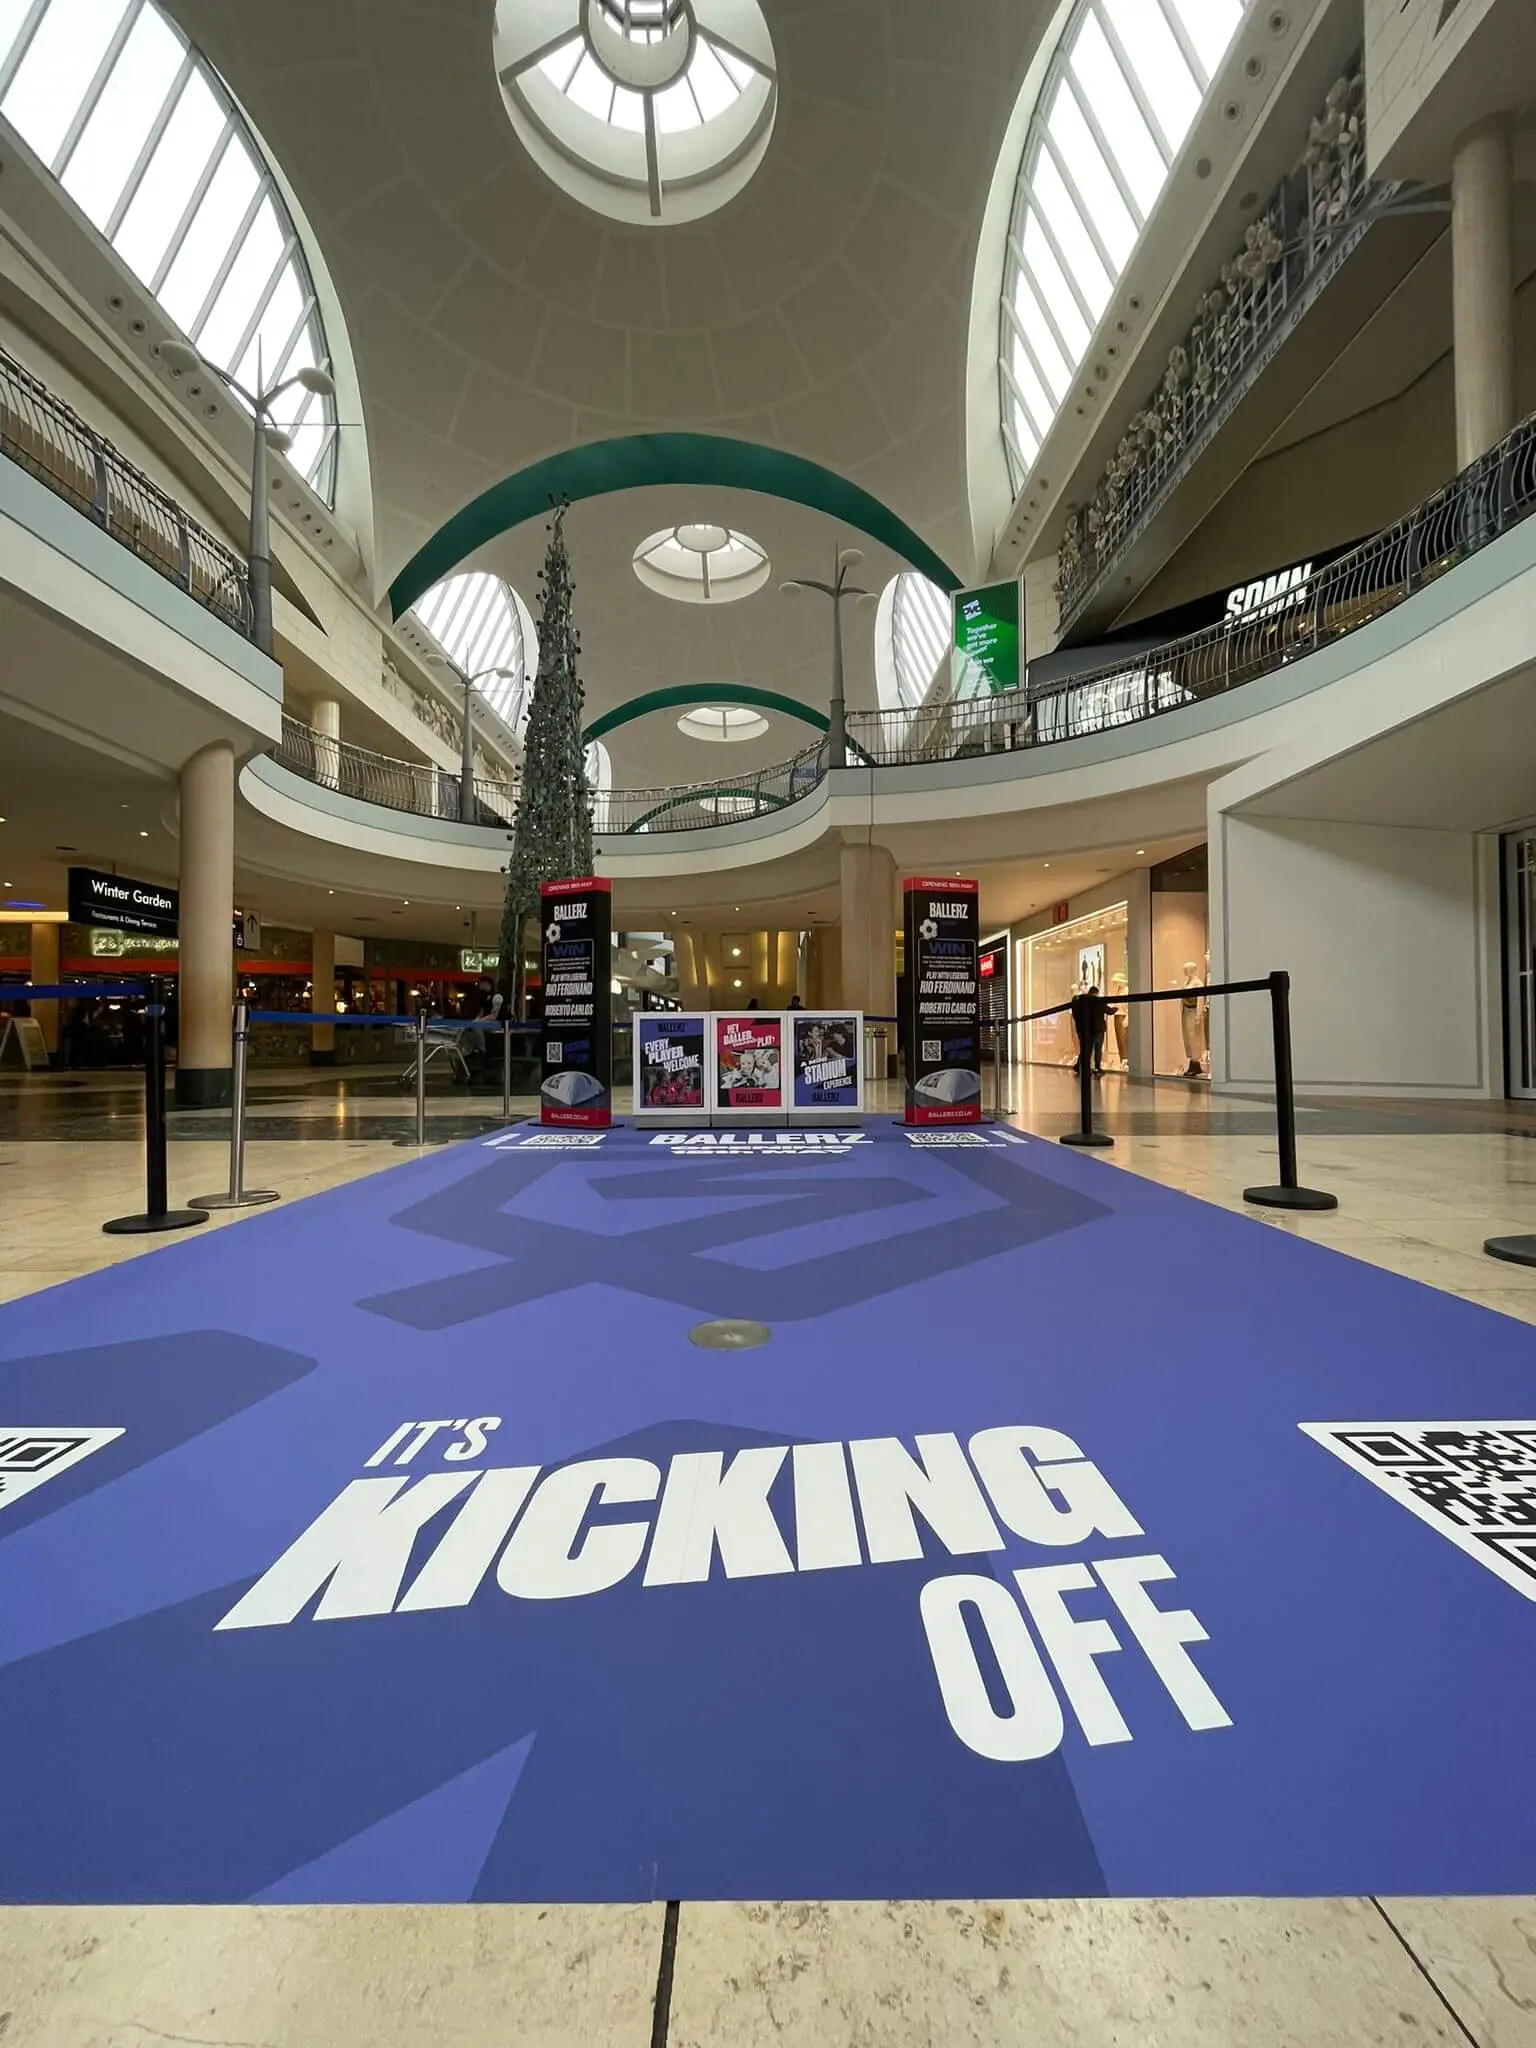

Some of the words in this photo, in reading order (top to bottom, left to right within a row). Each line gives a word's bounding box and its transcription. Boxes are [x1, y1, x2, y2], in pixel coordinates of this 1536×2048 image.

[1224, 562, 1312, 629] SDMN
[92, 880, 130, 900] Winter
[133, 890, 172, 910] Garden
[554, 902, 588, 921] BALLERZ
[929, 902, 968, 919] BALLERZ
[552, 944, 585, 956] WIN
[929, 942, 966, 956] WIN
[920, 981, 934, 994] RIO
[934, 981, 976, 994] FERDINAND
[570, 1003, 594, 1016] CARLOS
[919, 1002, 950, 1014] ROBERTO
[950, 1002, 977, 1014] CARLOS
[645, 1038, 670, 1054] EVERY
[723, 1030, 752, 1045] BALLER
[648, 1045, 684, 1064] PLAYER
[663, 1054, 700, 1072] WELCOME
[804, 1059, 846, 1085] STADIUM
[823, 1076, 852, 1090] EXPERIENCE
[649, 1134, 874, 1144] BALLERZ
[363, 1416, 501, 1468] IT'S
[213, 1425, 1145, 1631] KICKING
[920, 1555, 1234, 1762] OFF
